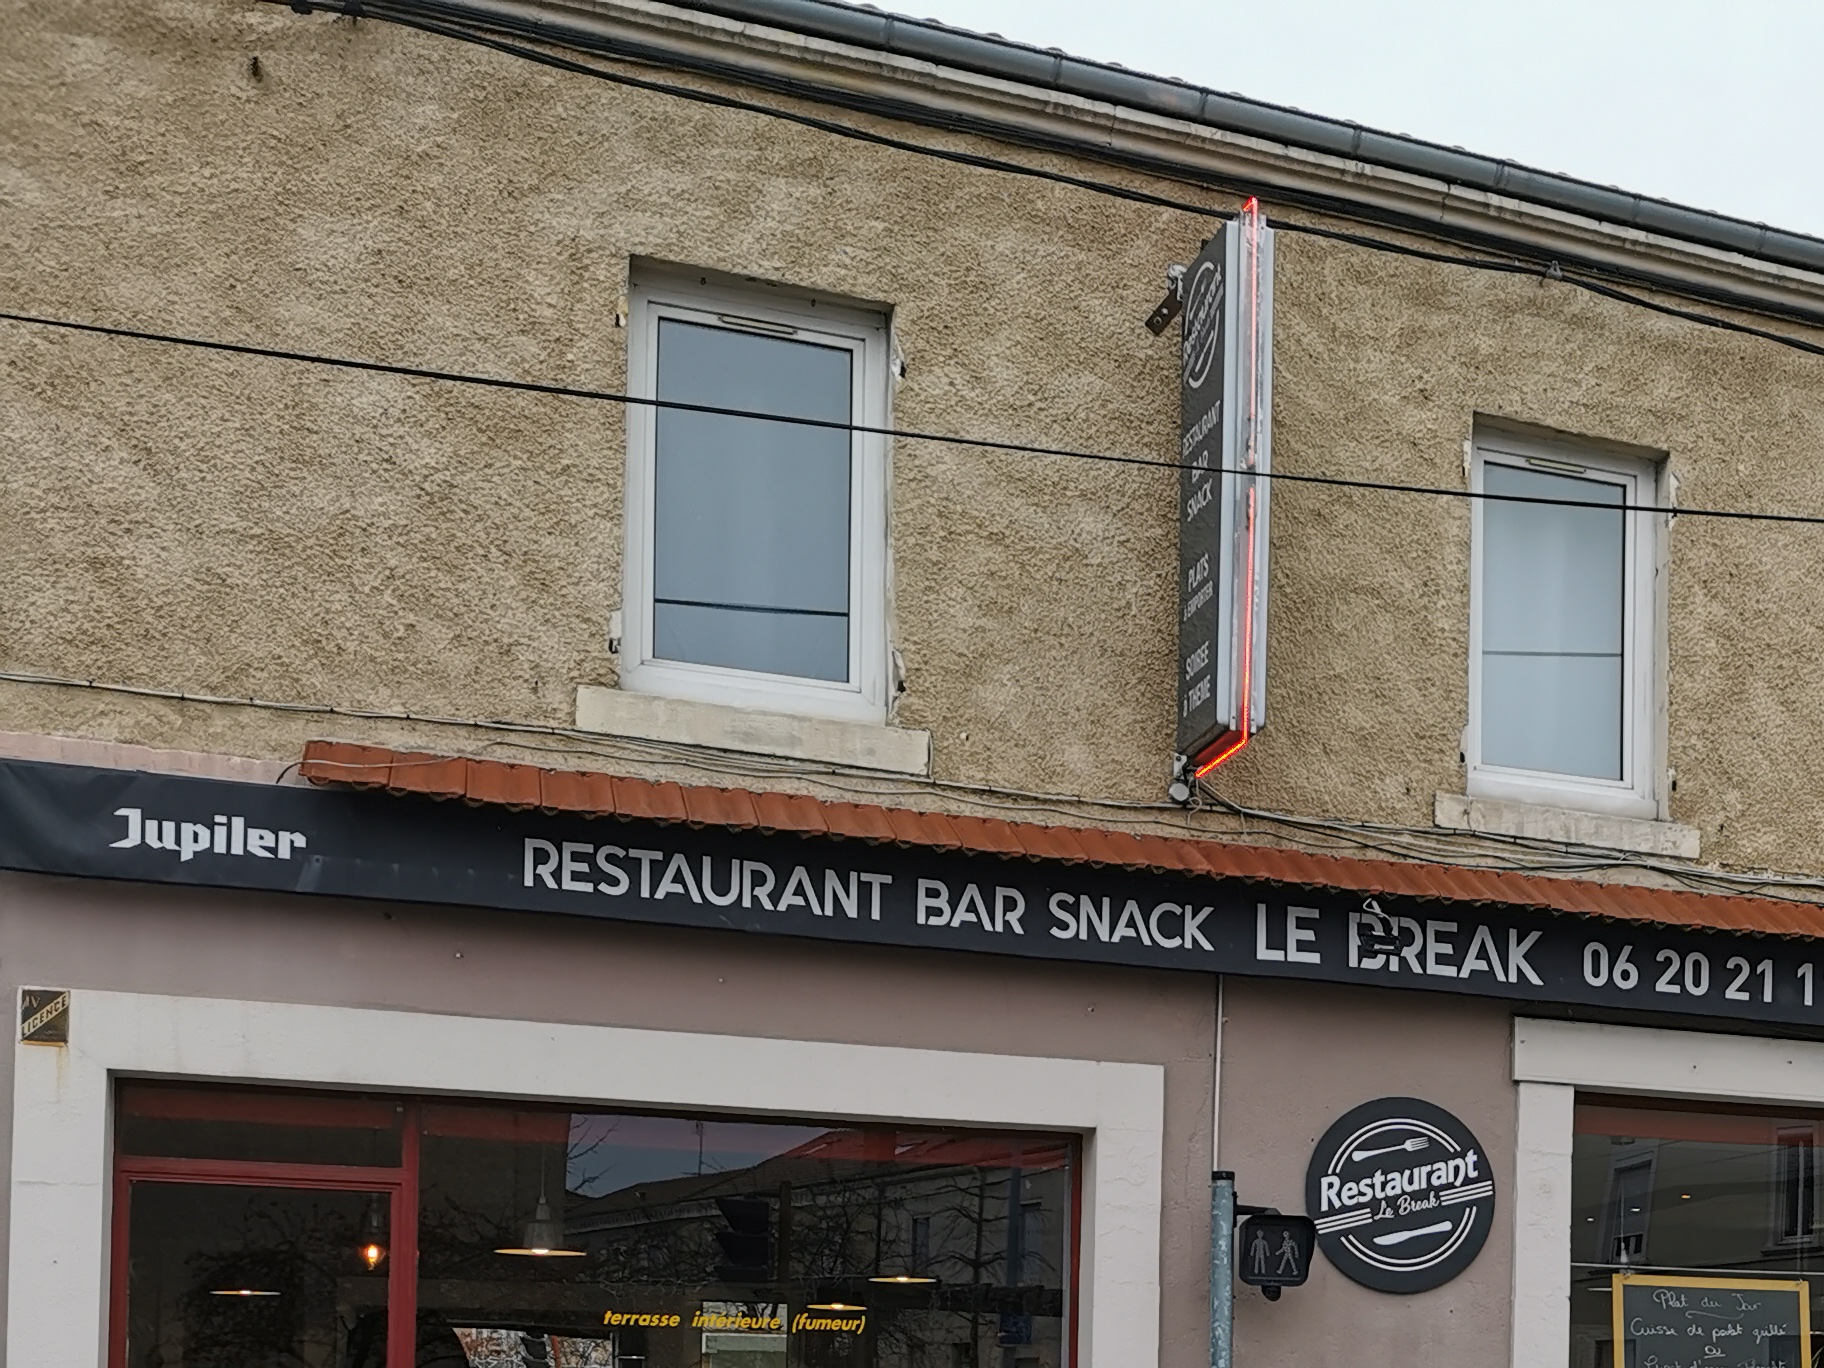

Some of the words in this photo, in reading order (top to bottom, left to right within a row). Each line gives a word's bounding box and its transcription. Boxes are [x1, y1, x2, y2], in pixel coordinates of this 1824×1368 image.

[1183, 400, 1220, 458] RESTAURANT
[1192, 450, 1209, 483] BAR
[1187, 479, 1212, 521] SNACK
[1188, 553, 1209, 592] PLATS
[109, 808, 307, 862] Jupiler
[523, 838, 892, 920] RESTAURANT
[916, 880, 1025, 935] BAR
[1048, 892, 1215, 951] SNACK
[1256, 903, 1322, 964] LE
[1348, 911, 1544, 986] BREAK
[1582, 942, 1639, 989] 06
[1656, 949, 1709, 996] 20
[1725, 956, 1774, 1003] 21
[22, 995, 67, 1036] LICENCE
[1320, 1149, 1479, 1212] Restaurant
[1374, 1200, 1394, 1220] Le
[1397, 1191, 1440, 1216] Break
[1653, 1289, 1689, 1310] Plat
[1700, 1295, 1721, 1307] du
[603, 1310, 680, 1327] terrasse
[691, 1311, 781, 1329] intérieure
[792, 1312, 866, 1335] (fumeur)
[1630, 1317, 1678, 1336] Cuisse
[1687, 1324, 1705, 1336] de
